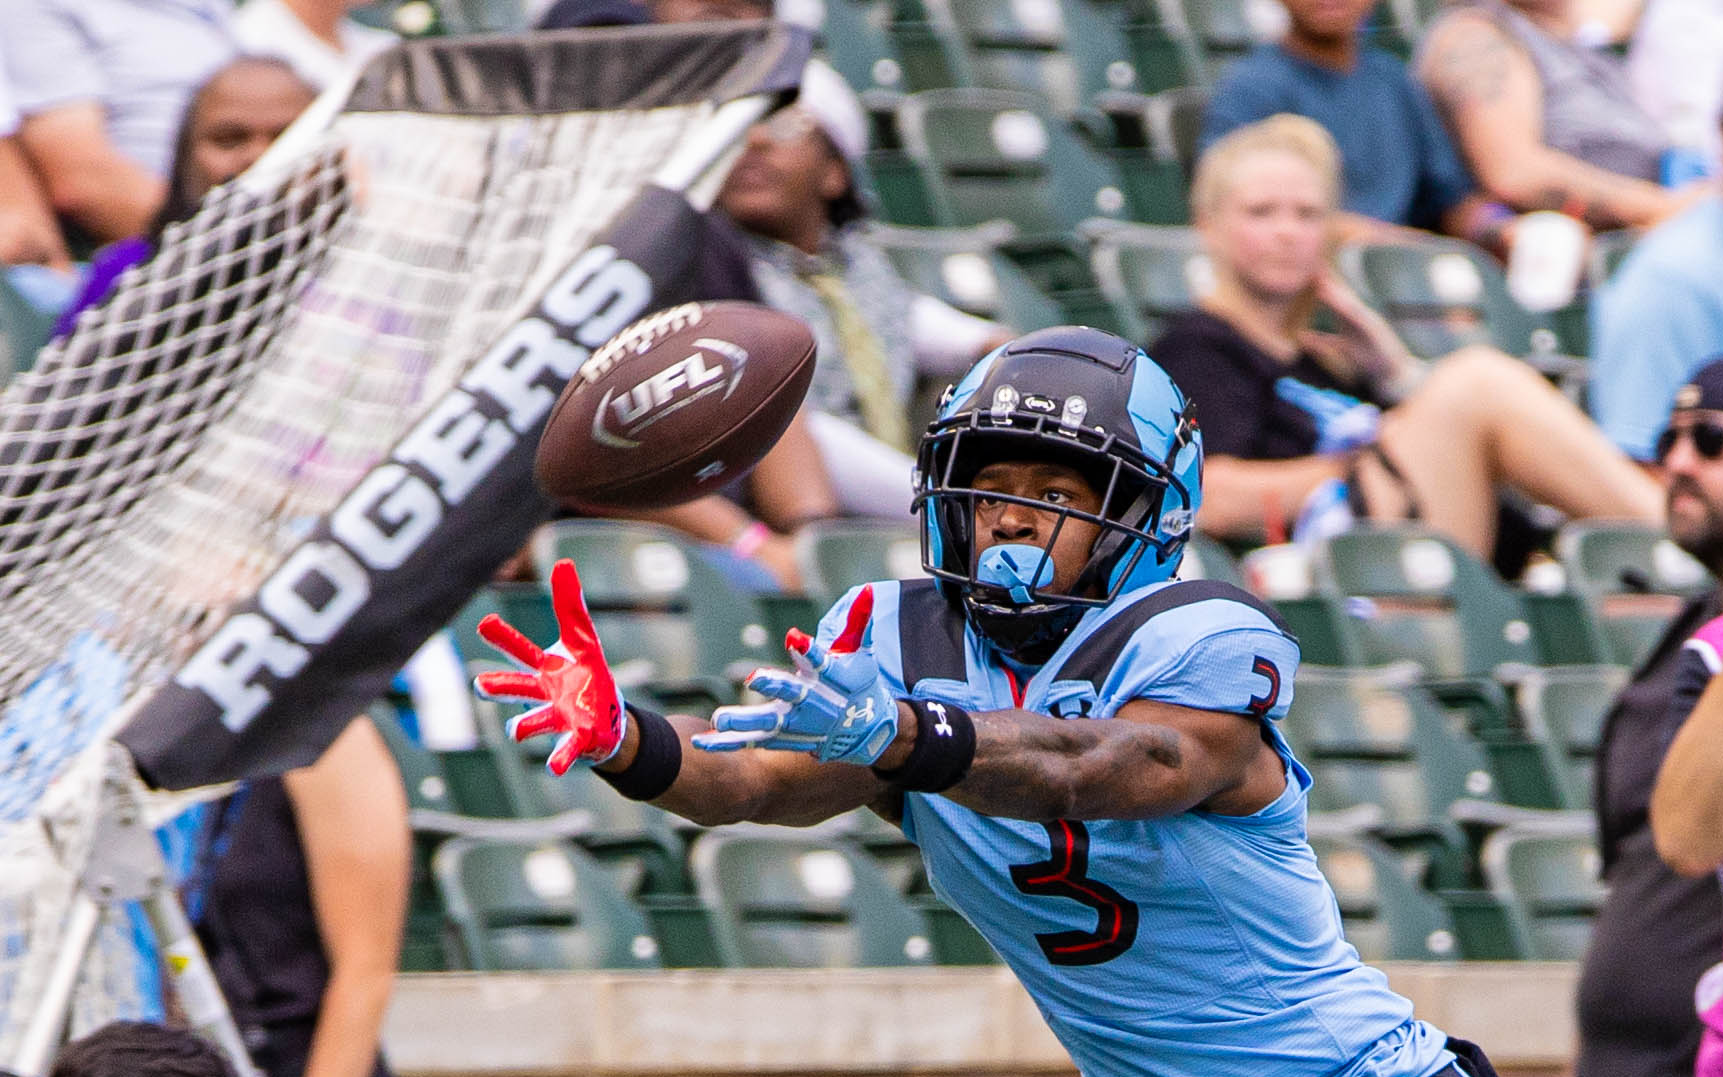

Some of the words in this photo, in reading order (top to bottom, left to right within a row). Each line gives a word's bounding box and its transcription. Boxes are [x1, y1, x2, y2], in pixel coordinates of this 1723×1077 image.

[608, 351, 725, 428] UFL
[174, 243, 655, 734] ROGERS
[1009, 818, 1140, 967] 3
